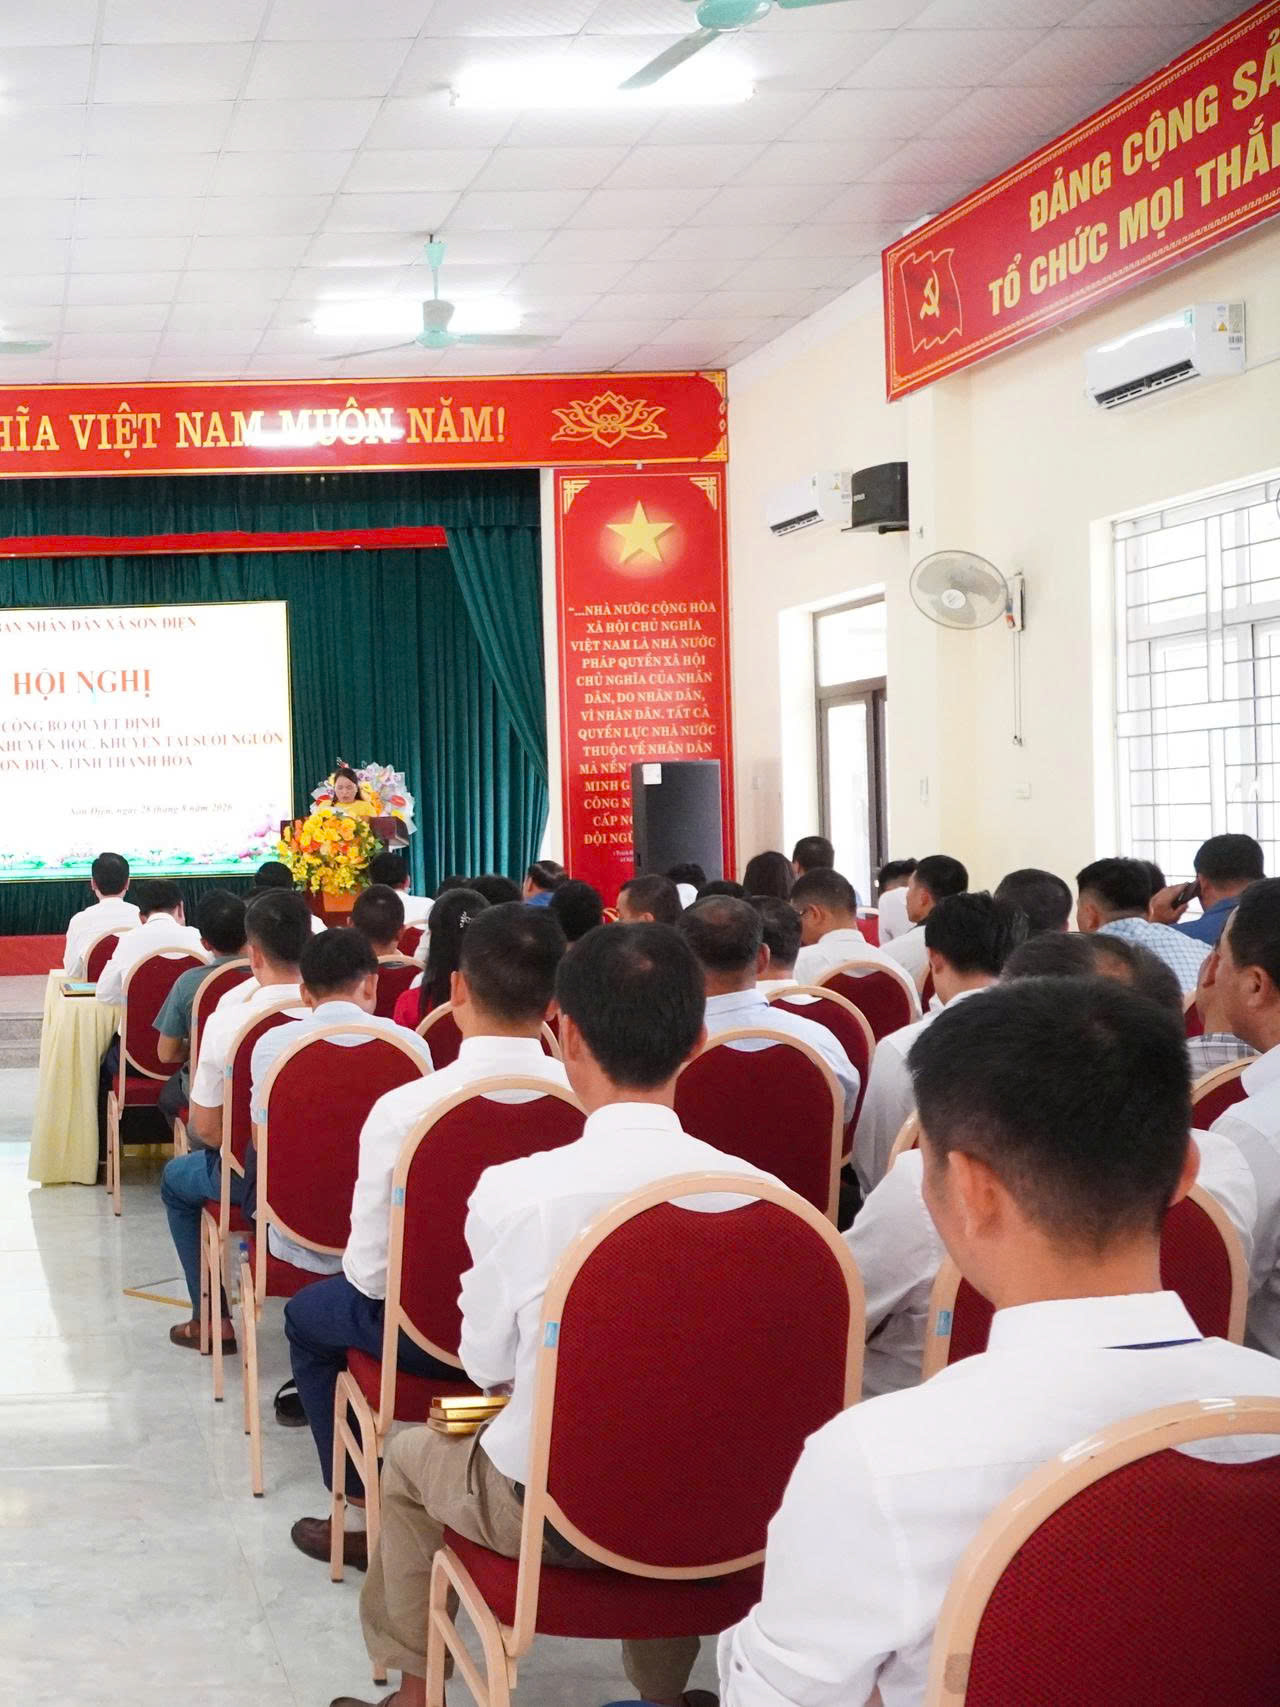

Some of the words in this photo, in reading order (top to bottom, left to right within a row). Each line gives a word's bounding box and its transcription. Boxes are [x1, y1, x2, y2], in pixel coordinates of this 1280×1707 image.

[1029, 151, 1112, 233] ĐẢNG
[1122, 84, 1219, 176] CỘNG
[988, 252, 1022, 317] TỔ
[1029, 221, 1109, 295] CHỨC
[1119, 177, 1184, 250] MỌI
[70, 402, 161, 459] VIỆT
[176, 409, 265, 449] NAM
[279, 396, 395, 446] MUÔN
[406, 396, 505, 444] NĂM!
[614, 603, 649, 615] NƯỚC
[651, 603, 687, 616] CỘNG
[690, 600, 716, 613] HÒA
[586, 620, 604, 634] XÃ
[606, 620, 629, 635] HỘI
[631, 618, 659, 632] CHỦ
[661, 618, 702, 632] NGHĨA
[571, 638, 601, 653] VIỆT
[603, 640, 630, 651] NAM
[633, 637, 649, 650] LÀ
[652, 636, 678, 649] NHÀ
[681, 635, 716, 649] NƯỚC
[582, 655, 616, 669] PHÁP
[683, 653, 705, 668] HỘI
[13, 667, 65, 701] HỘI
[77, 669, 151, 698] NGHỊ
[576, 672, 603, 687] CHỦ
[606, 672, 646, 685] NGHĨA
[649, 671, 675, 684] CỦA
[677, 670, 712, 683] NHÂN
[617, 693, 634, 703] DO
[637, 691, 673, 703] NHÂN
[596, 708, 632, 721] NHÂN
[624, 726, 649, 739] LỰC
[652, 723, 678, 737] NHÀ
[681, 723, 716, 736] NƯỚC
[583, 743, 627, 757] THUỘC
[648, 741, 684, 754] NHÂN
[687, 740, 712, 753] DÂN
[585, 780, 618, 792] MINH
[584, 795, 619, 809] CÔNG
[593, 812, 618, 827] CẤP
[584, 831, 607, 846] ĐỘI
